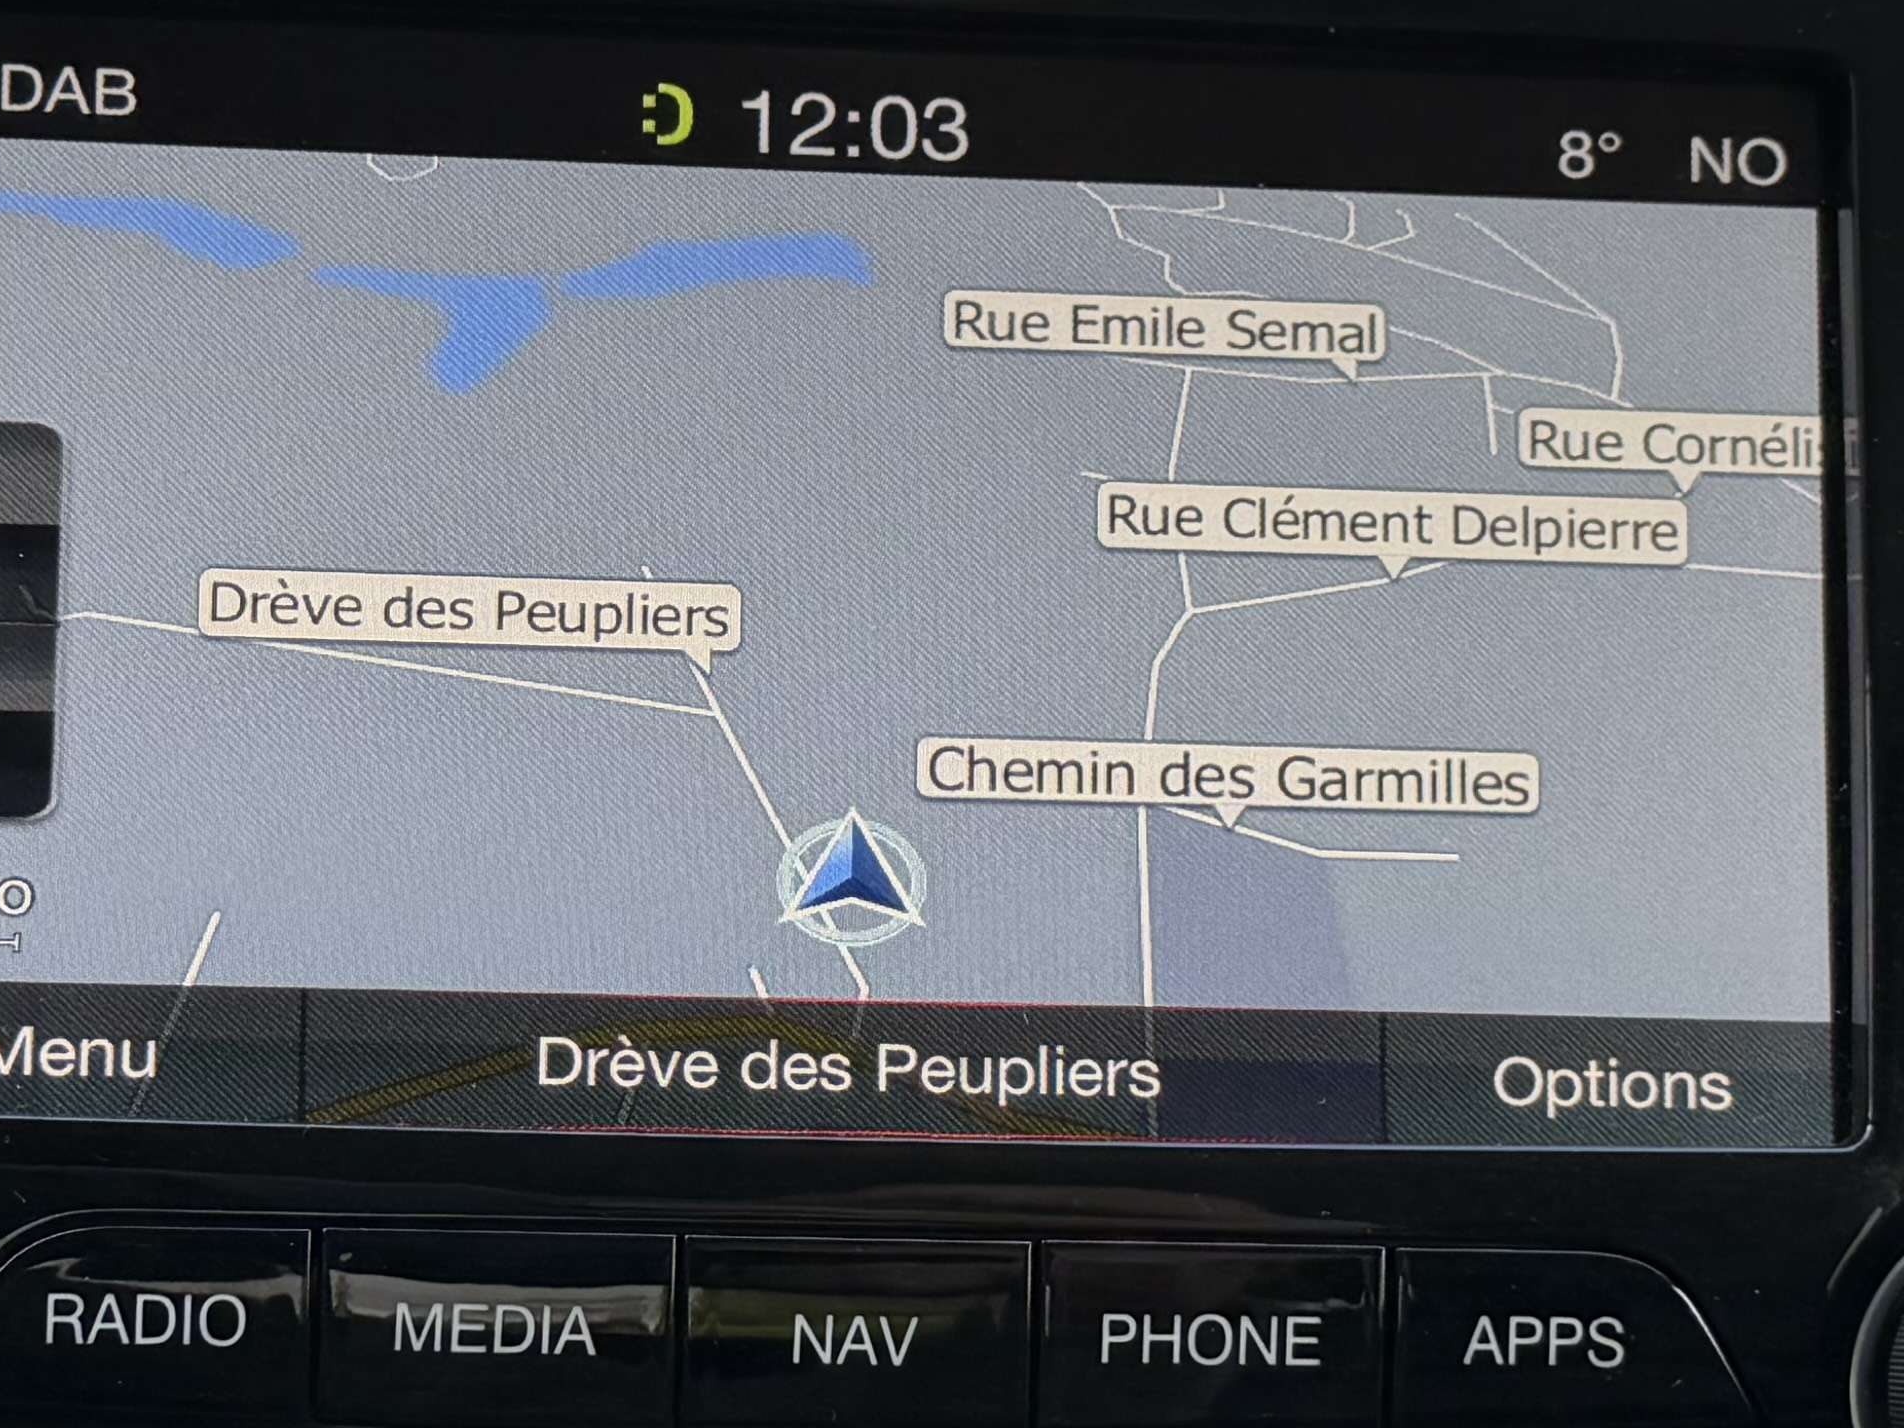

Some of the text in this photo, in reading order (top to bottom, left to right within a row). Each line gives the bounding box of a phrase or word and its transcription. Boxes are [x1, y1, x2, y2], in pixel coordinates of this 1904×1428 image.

[0, 61, 138, 118] DAB
[740, 88, 970, 164] 12:03
[1689, 136, 1788, 186] NO
[953, 300, 1378, 355] Rue Emile Semal
[1529, 419, 1822, 468] Rue Cornéli
[1108, 492, 1680, 562] Rue Clément Delpierre
[209, 577, 729, 642] Drève des Peupliers
[927, 744, 1530, 807] Chemin des Garmilles
[538, 1034, 1163, 1110] Drève des Peupliers
[1495, 1053, 1733, 1123] Options
[44, 1291, 249, 1348] RADIO
[392, 1301, 597, 1357] MEDIA
[792, 1313, 918, 1366] NAV
[1100, 1312, 1322, 1367] PHONE
[1463, 1315, 1626, 1369] APPS
